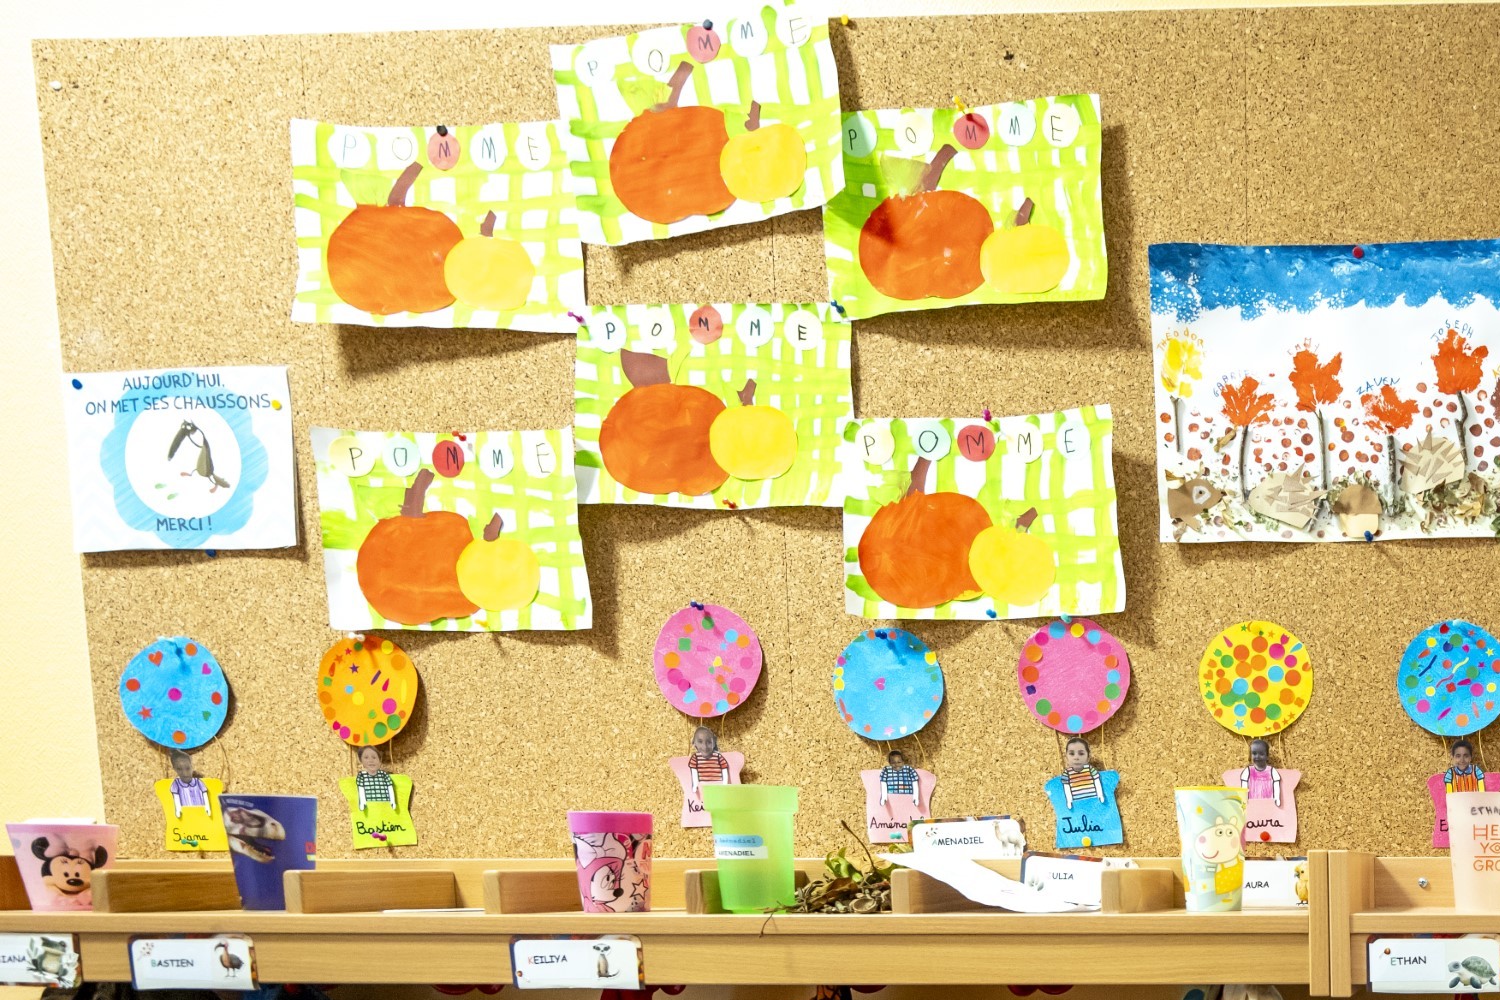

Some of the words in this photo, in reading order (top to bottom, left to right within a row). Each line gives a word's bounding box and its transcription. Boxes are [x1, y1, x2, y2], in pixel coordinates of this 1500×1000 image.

[1356, 377, 1400, 395] ZAVEN
[86, 400, 106, 415] ON
[111, 398, 138, 413] MET
[143, 396, 169, 410] SES
[174, 394, 271, 410] CHAUSSONS
[157, 517, 203, 531] MERCI
[356, 820, 407, 836] Bastien
[1062, 816, 1104, 835] Julia
[931, 836, 985, 847] AMENADIEL
[150, 957, 194, 968] BASTIEN
[527, 954, 568, 965] KEILIYA
[1390, 954, 1427, 967] ETHAN
